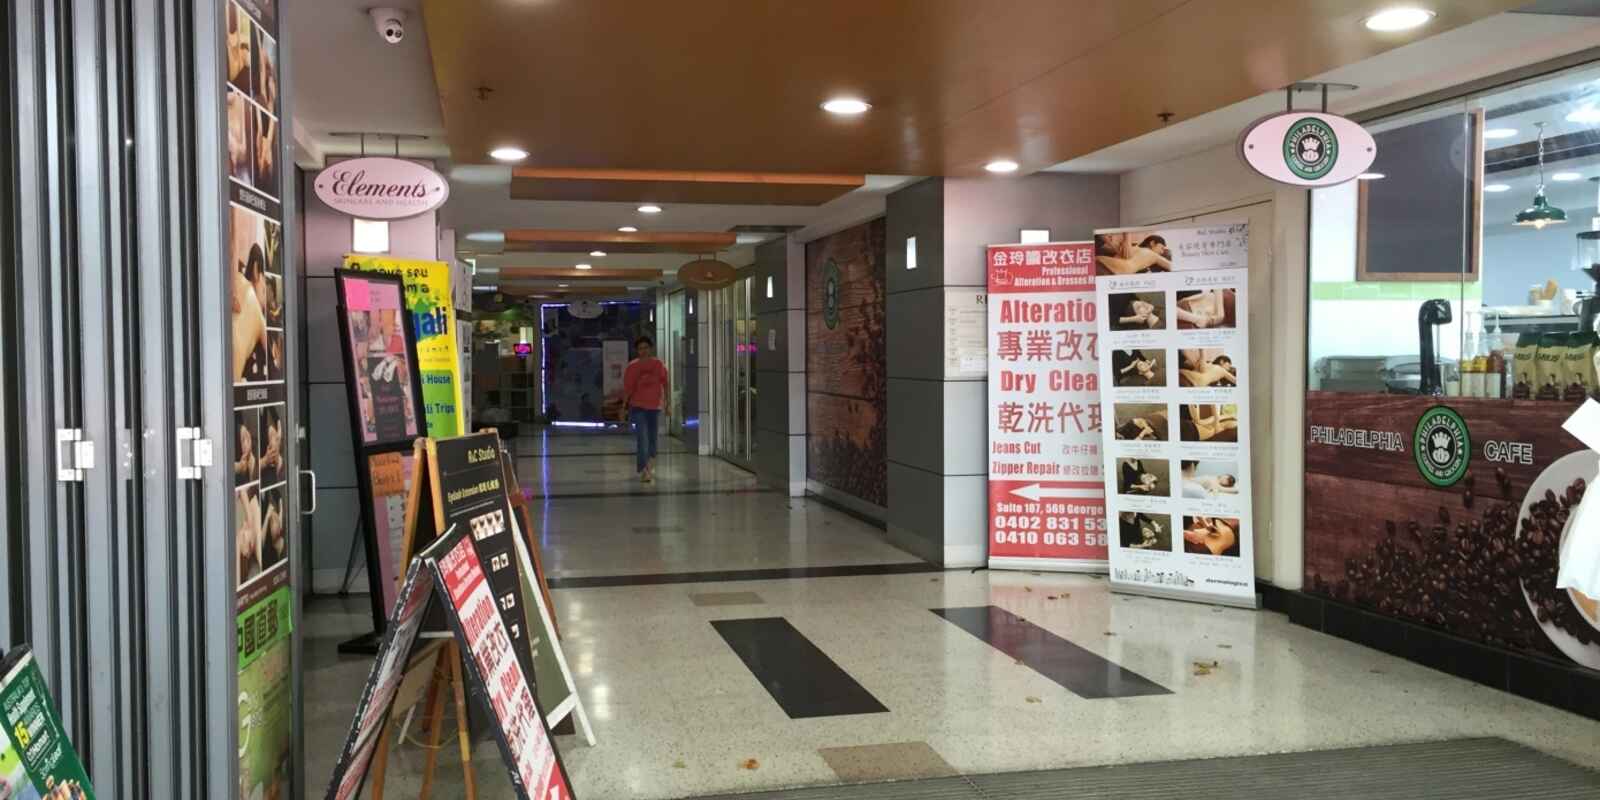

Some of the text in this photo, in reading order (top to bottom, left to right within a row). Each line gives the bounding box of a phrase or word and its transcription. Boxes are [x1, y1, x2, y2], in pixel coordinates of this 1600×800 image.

[332, 169, 427, 198] Elements
[1041, 266, 1089, 276] Professional
[1014, 277, 1050, 287] Alteration
[1000, 299, 1097, 323] Alteratio
[1001, 369, 1098, 393] Dry Clea
[1420, 415, 1463, 448] PHILADELPHIA
[992, 441, 1041, 454] Jeans Cut
[1311, 425, 1533, 464] PHILADELPHIA CAFE
[992, 461, 1060, 475] Zipper Repair
[996, 503, 1022, 513] Suite
[1067, 504, 1104, 515] George
[995, 515, 1107, 531] 0402 831 53
[995, 530, 1038, 544] 0410
[15, 720, 31, 749] 15
